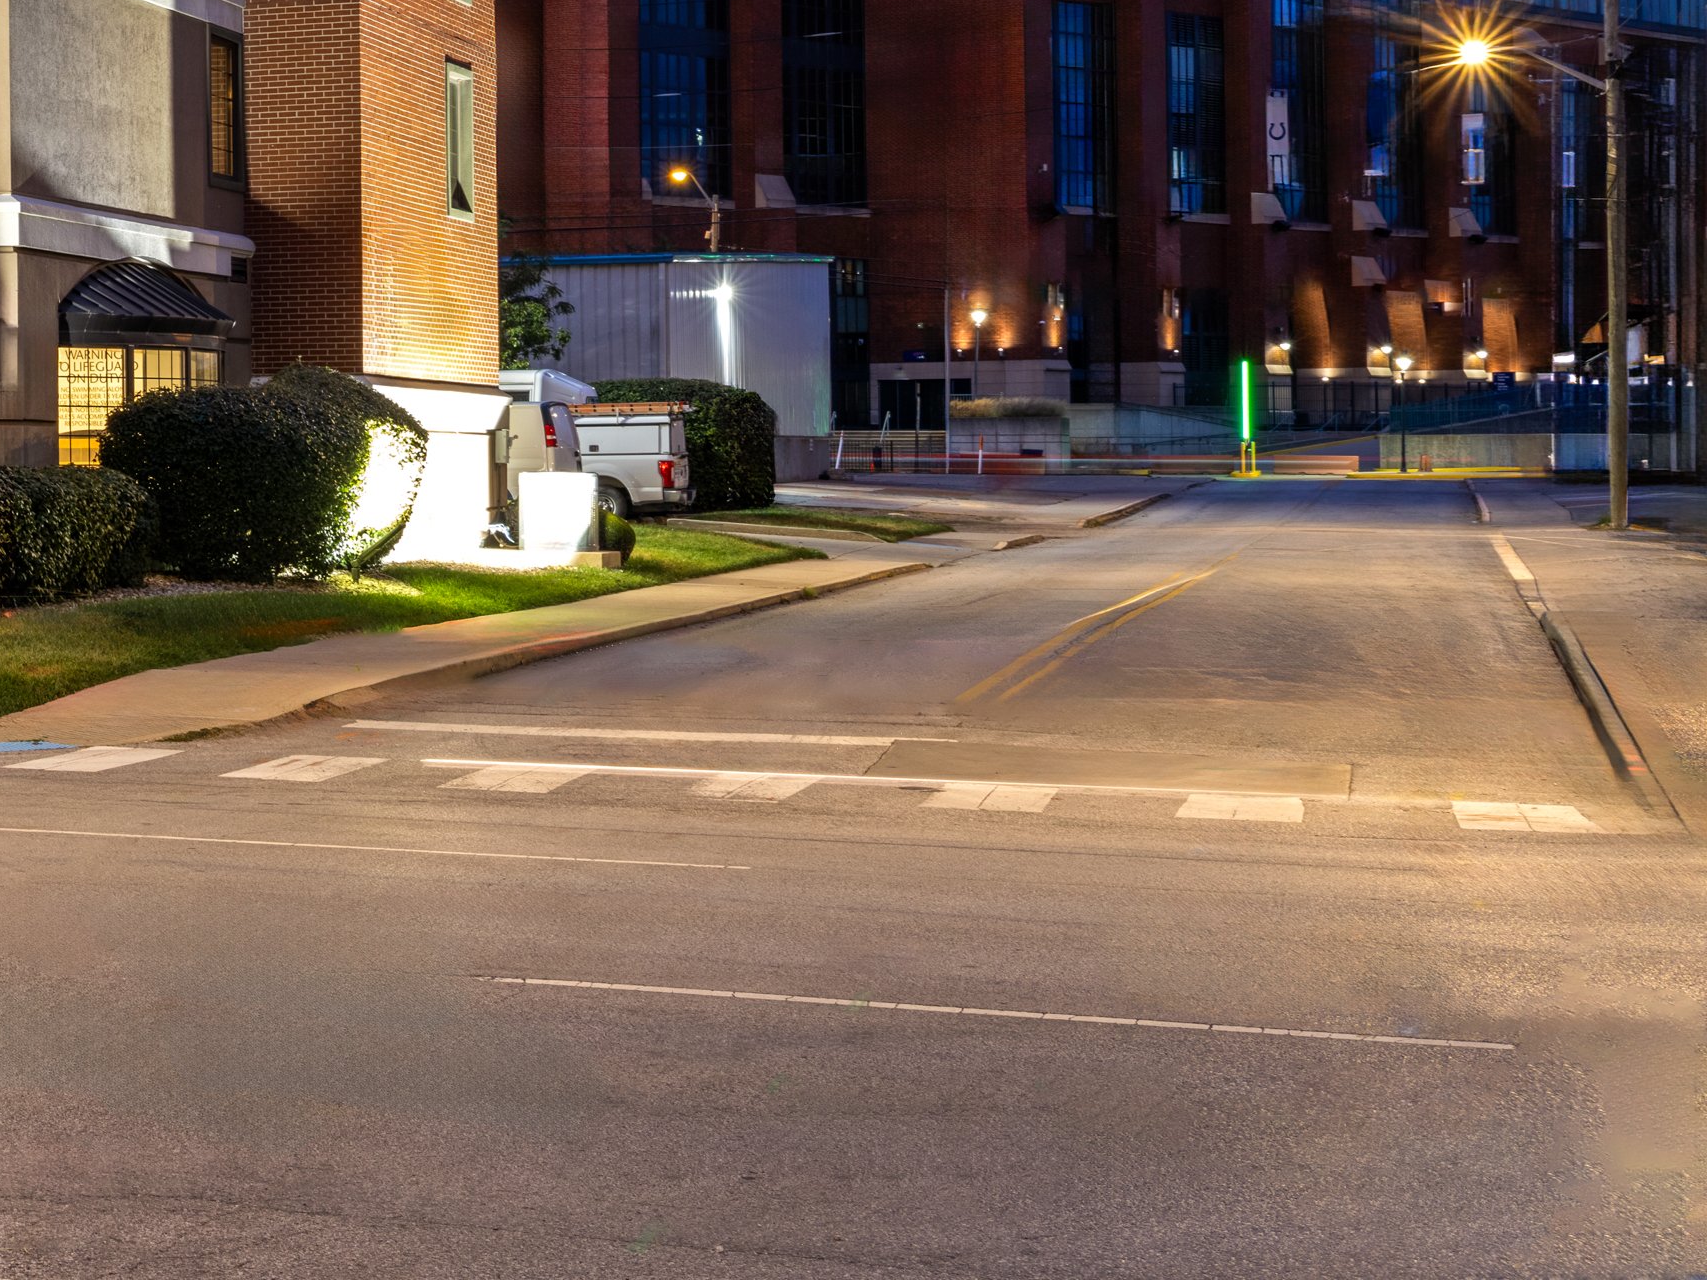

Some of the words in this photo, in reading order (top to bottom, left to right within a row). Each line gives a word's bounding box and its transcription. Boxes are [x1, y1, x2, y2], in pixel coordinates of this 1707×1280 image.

[74, 361, 139, 372] LIFEGUAD
[67, 373, 85, 383] ON
[90, 373, 123, 383] DUTY
